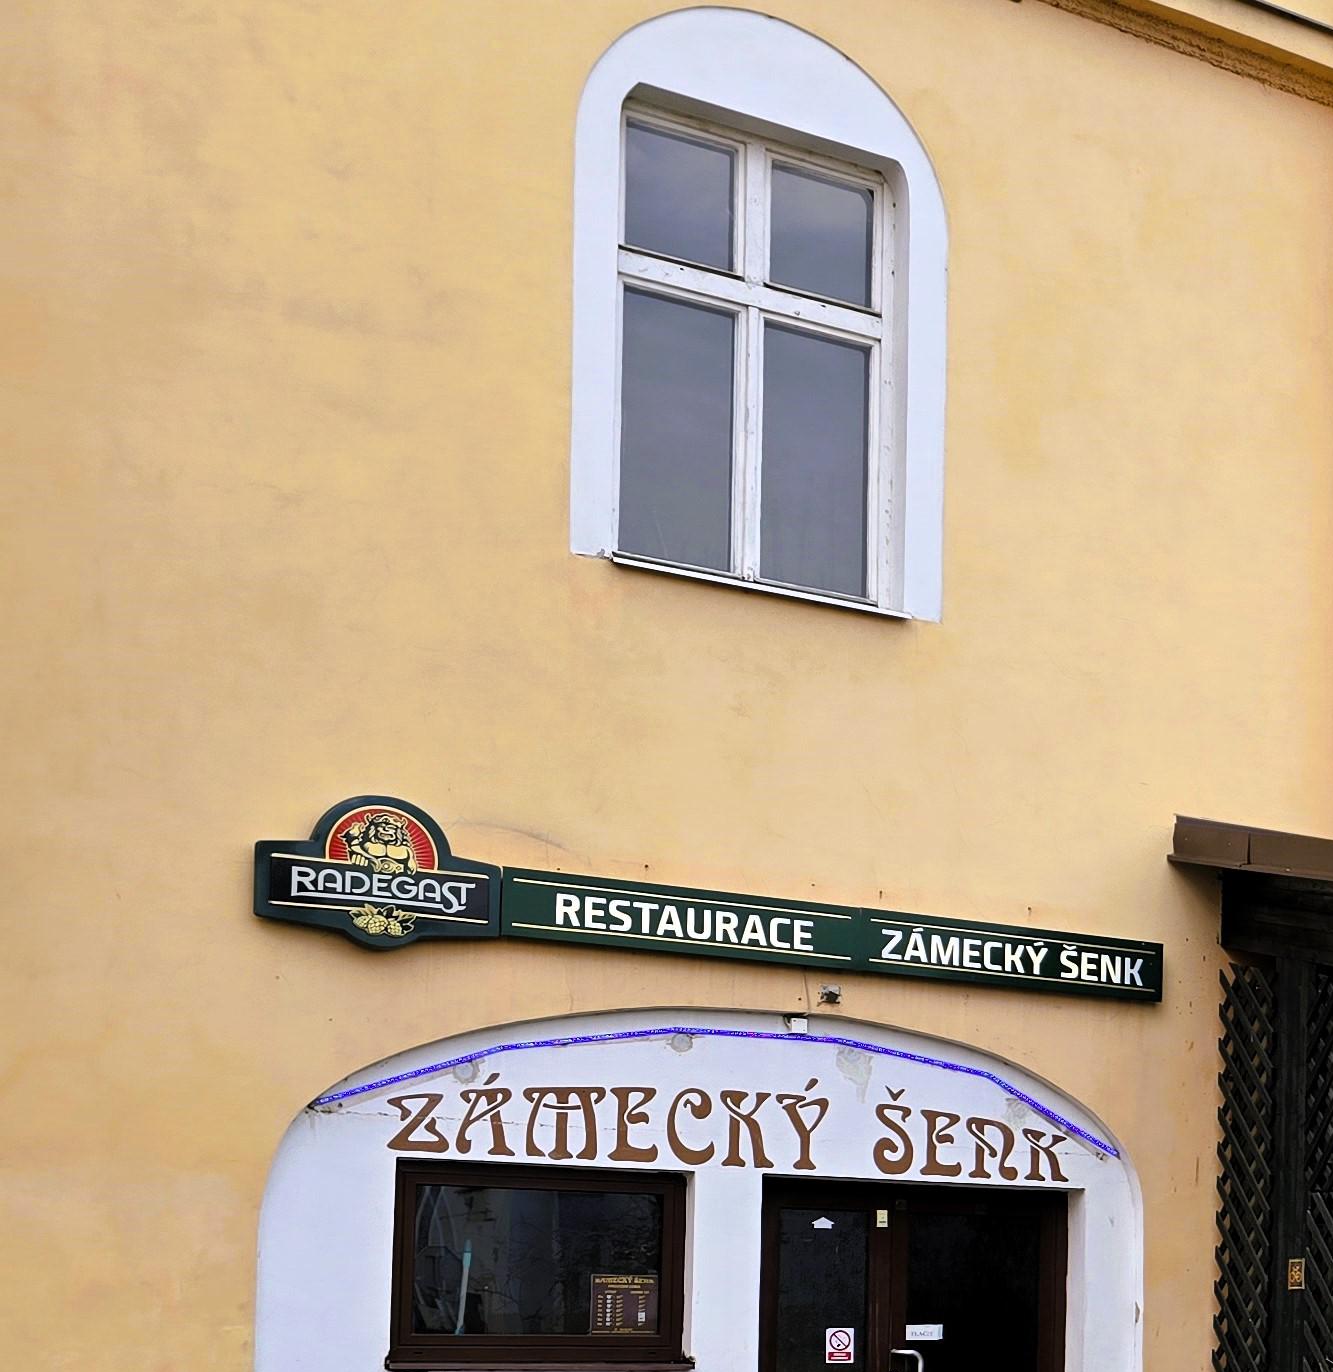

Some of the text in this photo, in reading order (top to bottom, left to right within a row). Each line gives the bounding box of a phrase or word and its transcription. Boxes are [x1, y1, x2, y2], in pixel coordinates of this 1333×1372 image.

[290, 865, 476, 913] RADEGAST
[555, 891, 1144, 986] RESTAURACE ZÁMECKÝ ŠENK
[387, 1072, 1070, 1183] ZÁMECKÝ ŠENK
